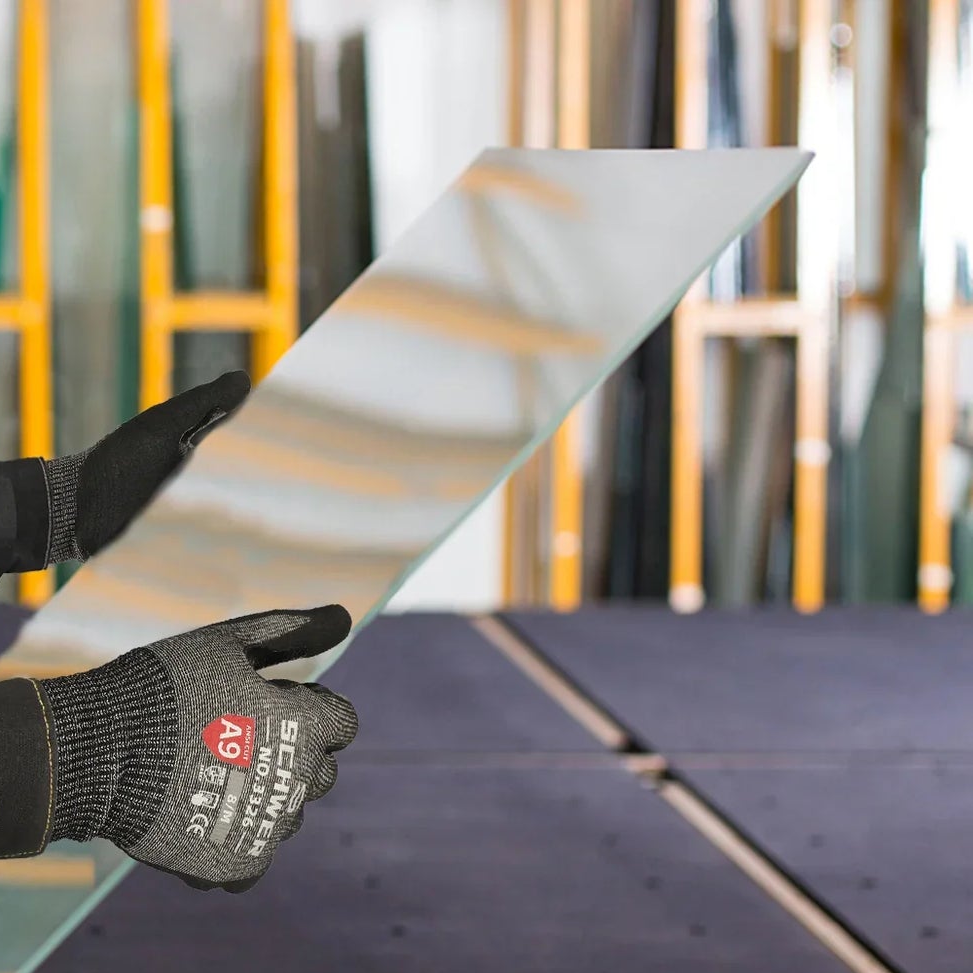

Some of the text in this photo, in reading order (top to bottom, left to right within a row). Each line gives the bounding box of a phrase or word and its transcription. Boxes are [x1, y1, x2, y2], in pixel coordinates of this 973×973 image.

[218, 718, 242, 759] A9
[220, 794, 237, 823] 8/M
[247, 720, 298, 857] SCHWER
